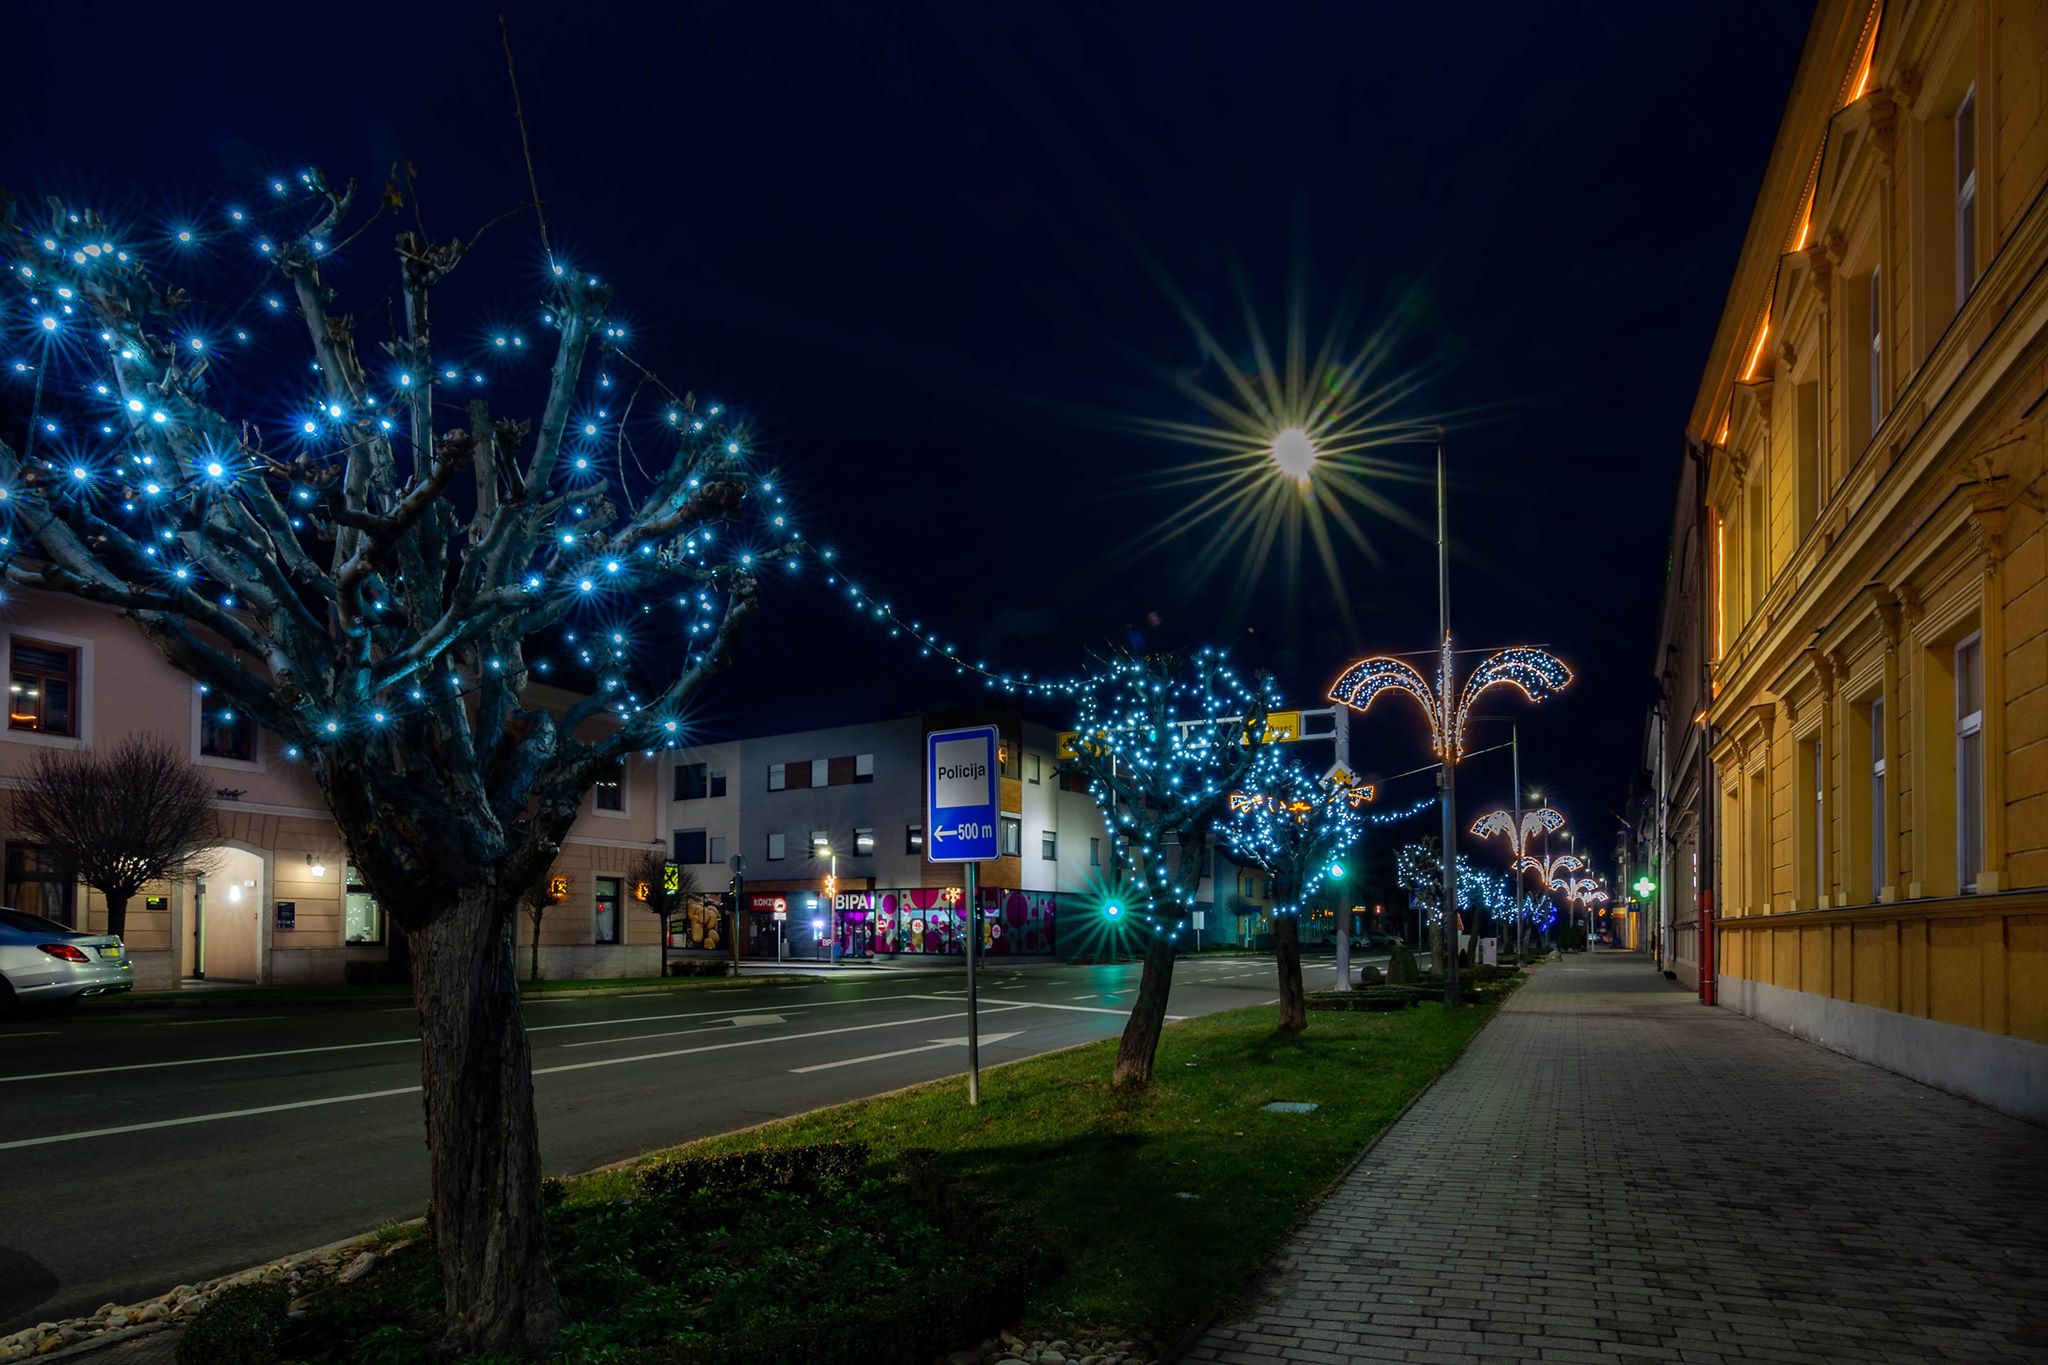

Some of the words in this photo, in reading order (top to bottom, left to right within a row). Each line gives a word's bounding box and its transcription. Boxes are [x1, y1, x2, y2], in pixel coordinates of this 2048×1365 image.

[938, 764, 986, 780] Policija
[958, 823, 979, 840] 500
[982, 825, 992, 838] m
[836, 894, 868, 909] BIPA
[822, 939, 833, 947] BIP
